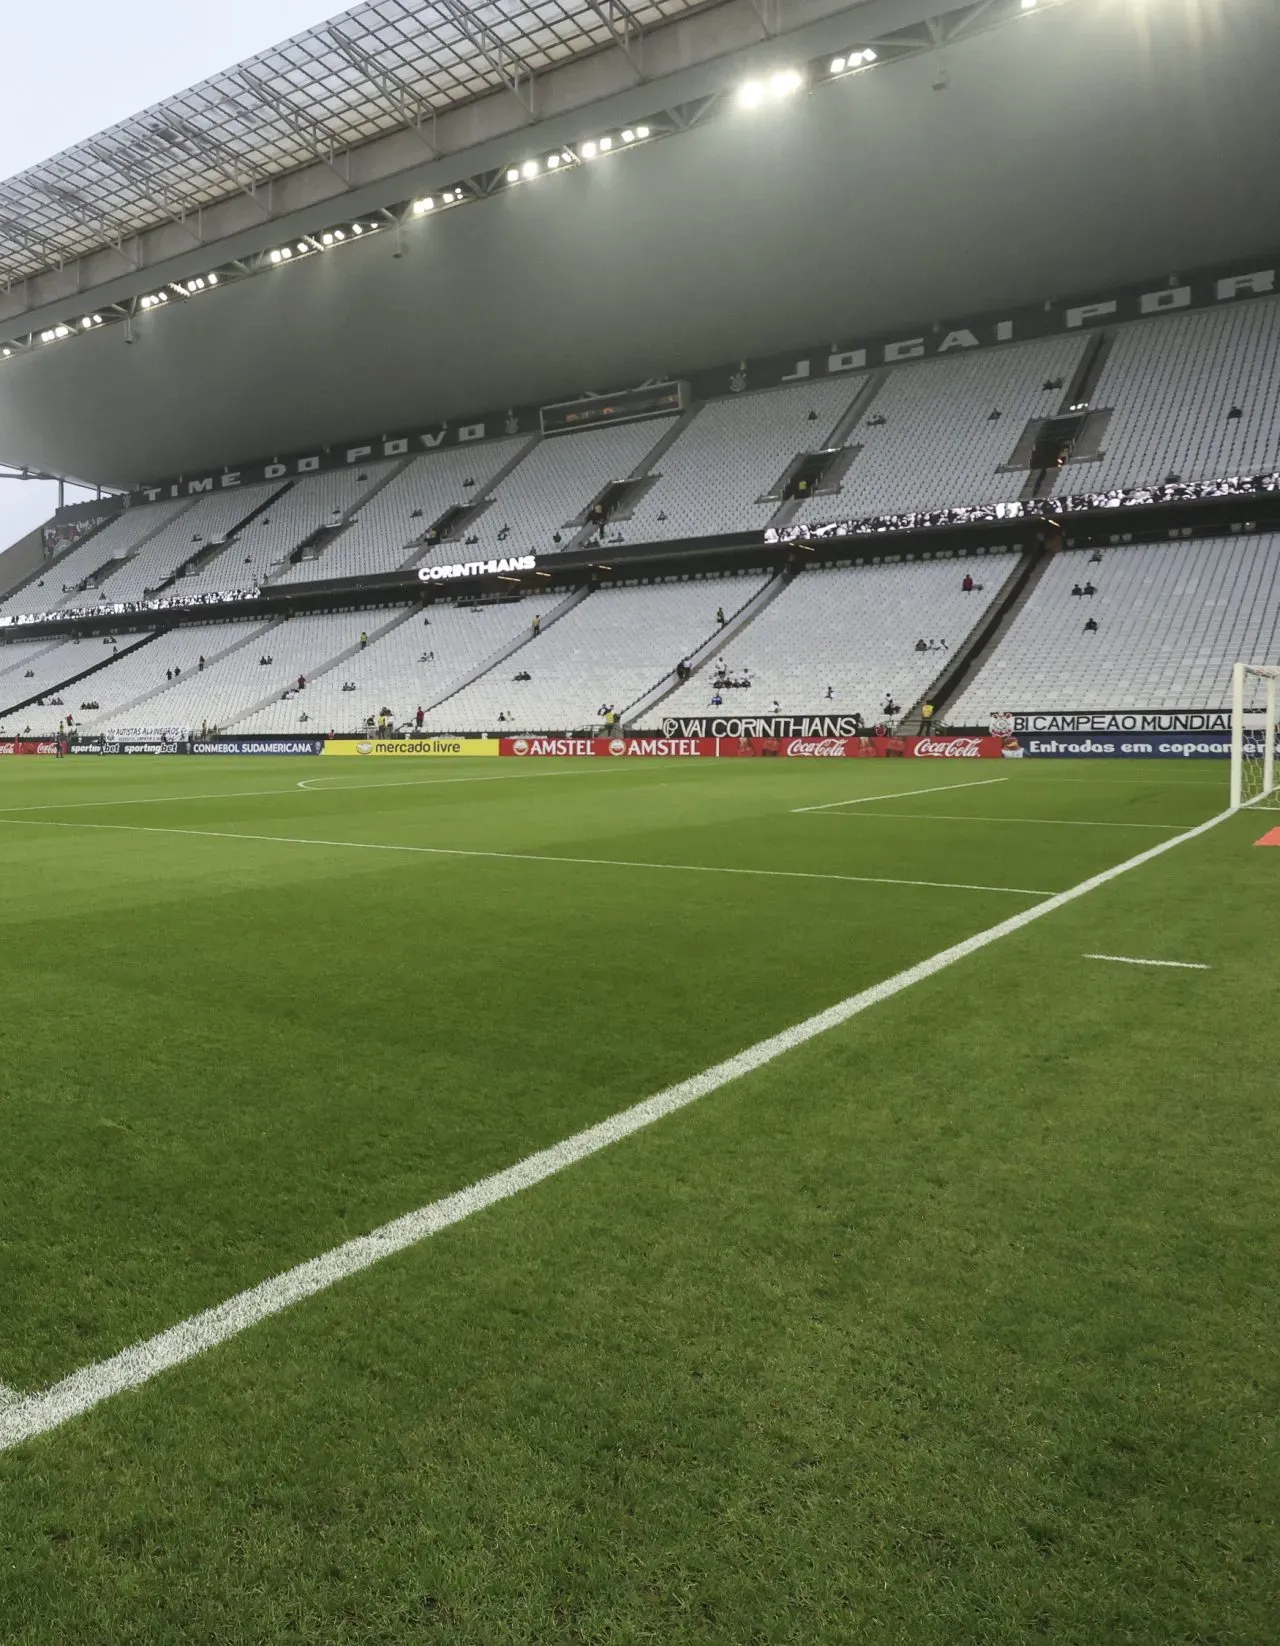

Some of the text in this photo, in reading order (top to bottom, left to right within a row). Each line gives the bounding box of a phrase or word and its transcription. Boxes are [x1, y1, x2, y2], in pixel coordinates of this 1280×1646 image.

[1067, 269, 1275, 328] POR
[144, 423, 485, 502] TIME DO POVO
[418, 555, 536, 581] CORINTHIANS
[679, 716, 857, 738] VAI CORINTHIANS
[1013, 715, 1029, 731] BI
[71, 742, 119, 754] sportinbet
[124, 742, 178, 755] sportingbet
[193, 742, 312, 753] CONMEBOL SUDAMERICANA
[375, 740, 461, 753] mercado livre
[530, 739, 596, 755] AMSTEL
[627, 739, 701, 755] AMSTEL
[787, 738, 847, 757] Coca-Cola
[914, 737, 981, 758] Coca-Cola
[1029, 739, 1116, 753] Entradas
[1120, 743, 1153, 753] em
